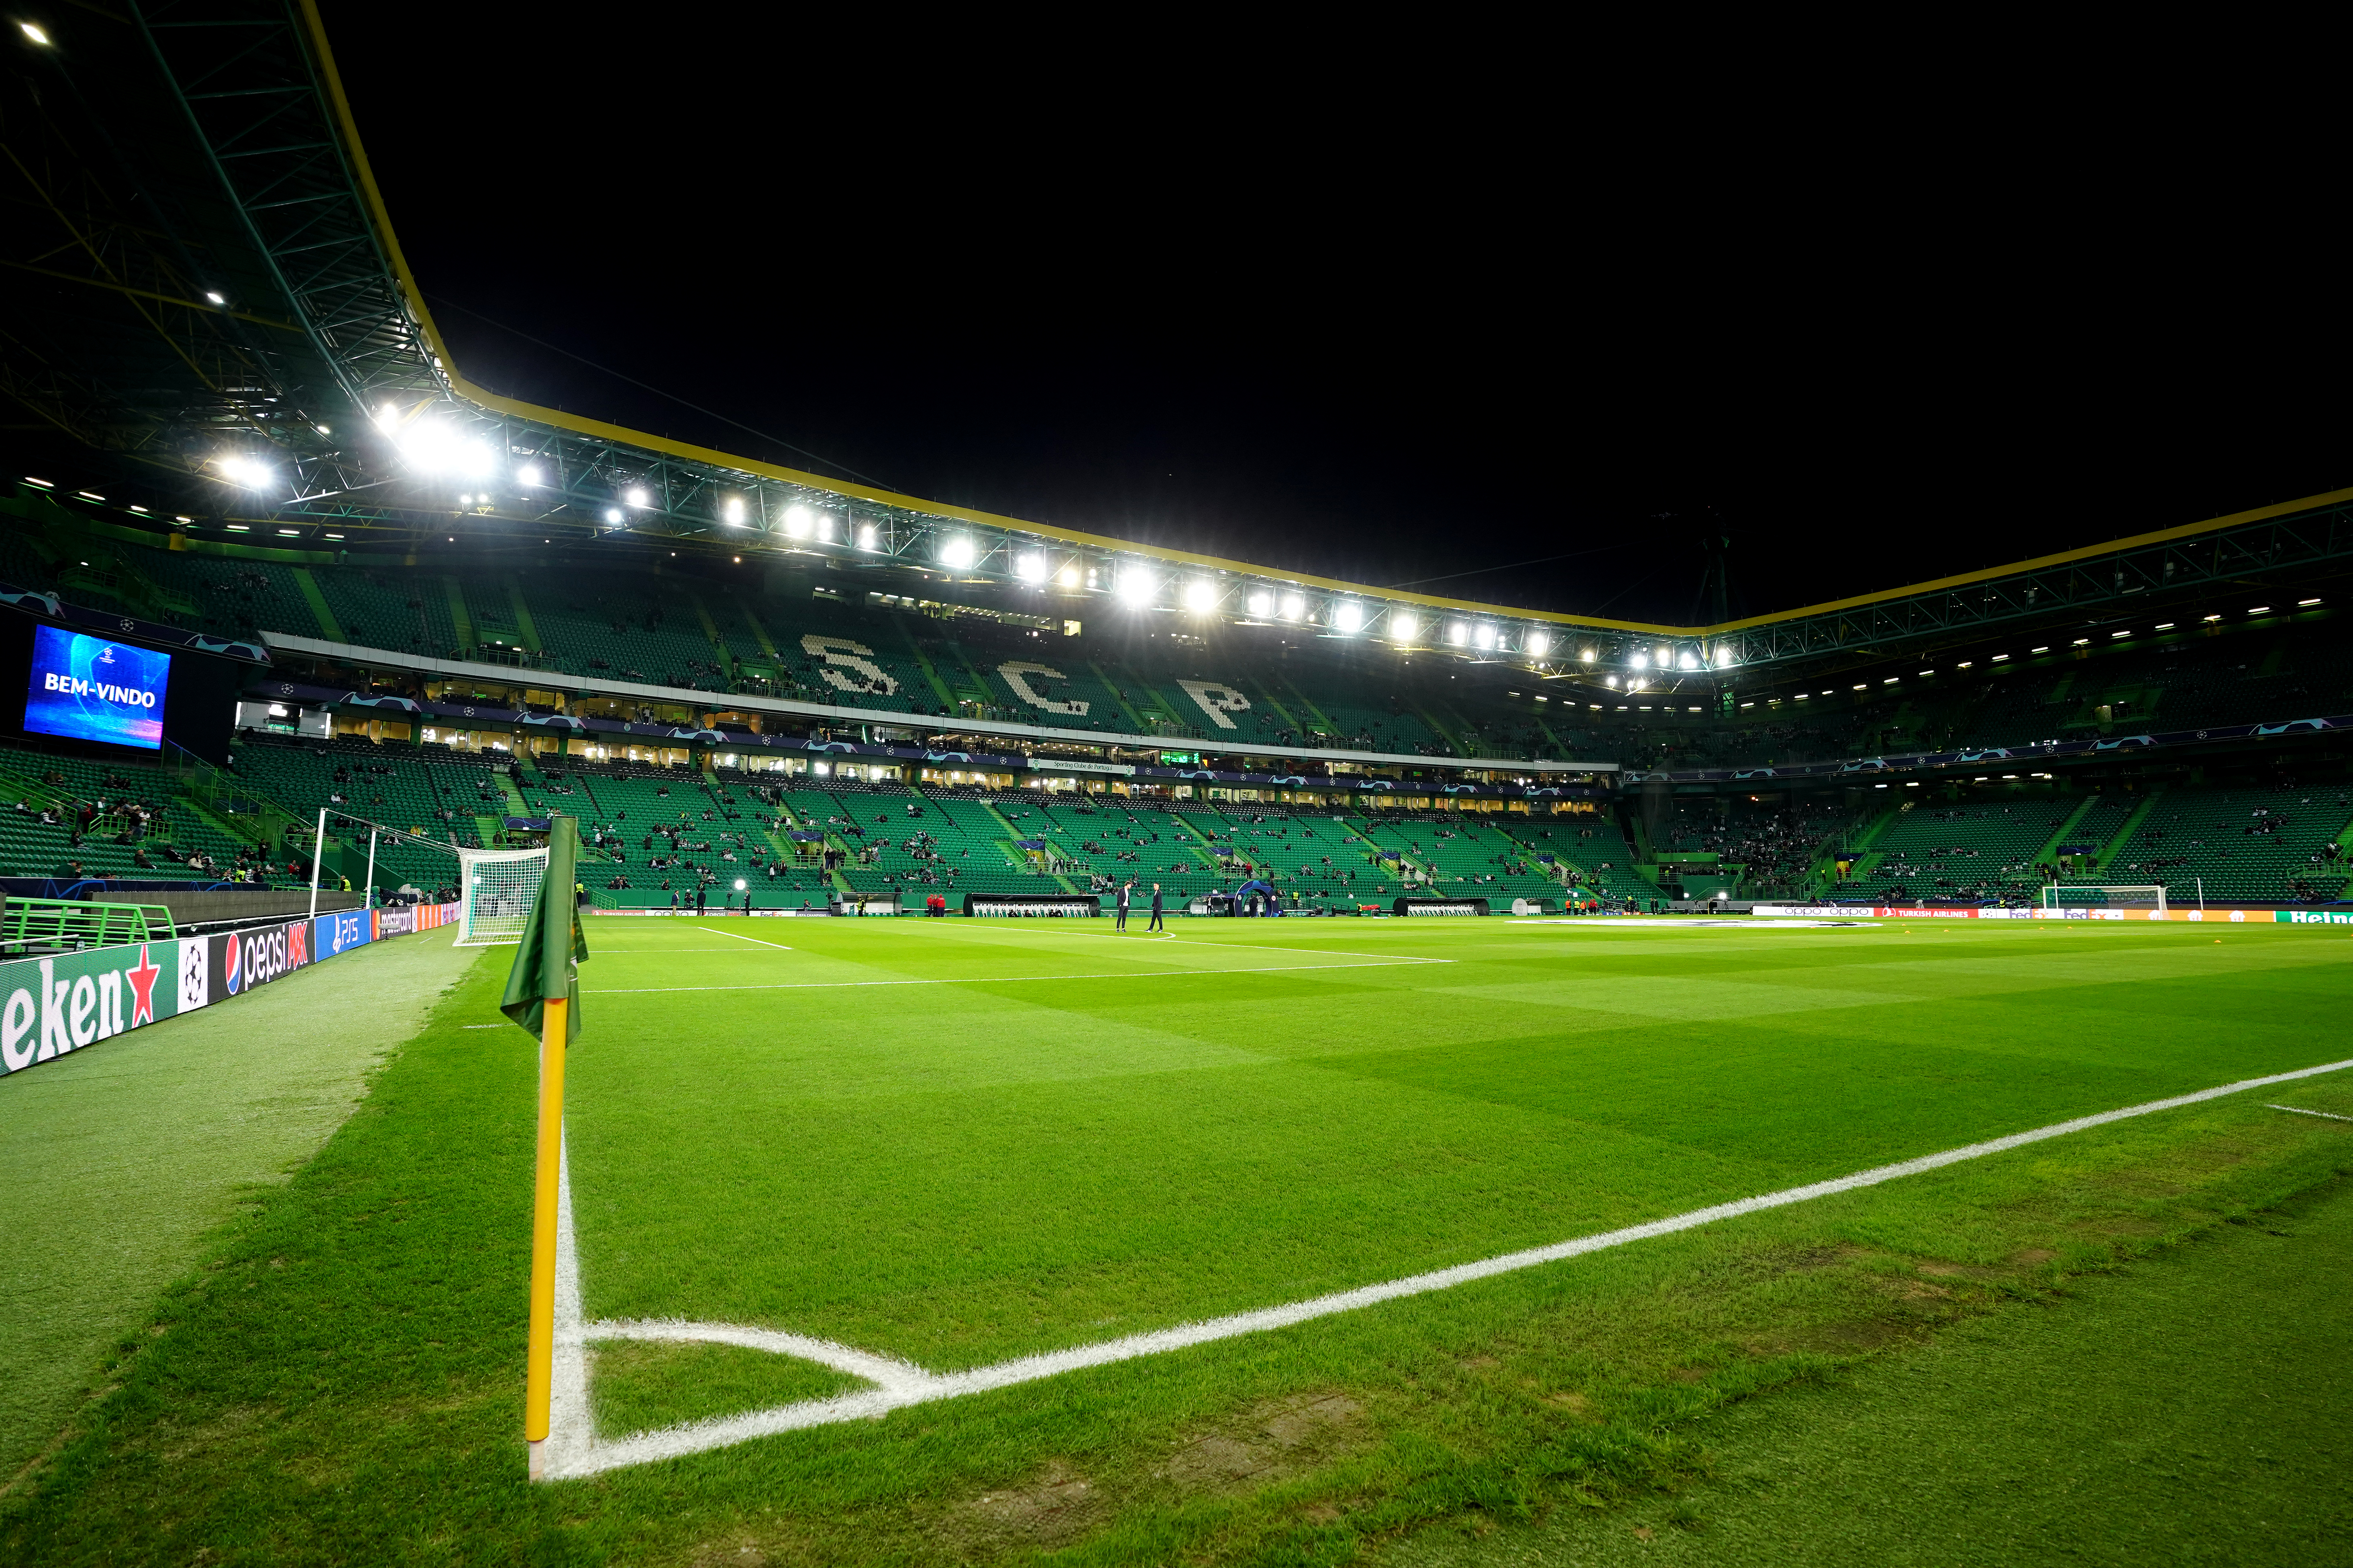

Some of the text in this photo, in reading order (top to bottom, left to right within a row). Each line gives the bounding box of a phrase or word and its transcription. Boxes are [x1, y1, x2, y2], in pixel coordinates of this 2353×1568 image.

[45, 672, 155, 708] BEM-VINDO
[381, 907, 411, 935] mastercard
[1785, 908, 1868, 916] oppo oppo
[2064, 909, 2107, 920] FedEx
[2290, 911, 2353, 924] Hein
[342, 918, 358, 945] PS5
[245, 921, 308, 991] pepsi MAX
[1, 958, 124, 1071] eken
